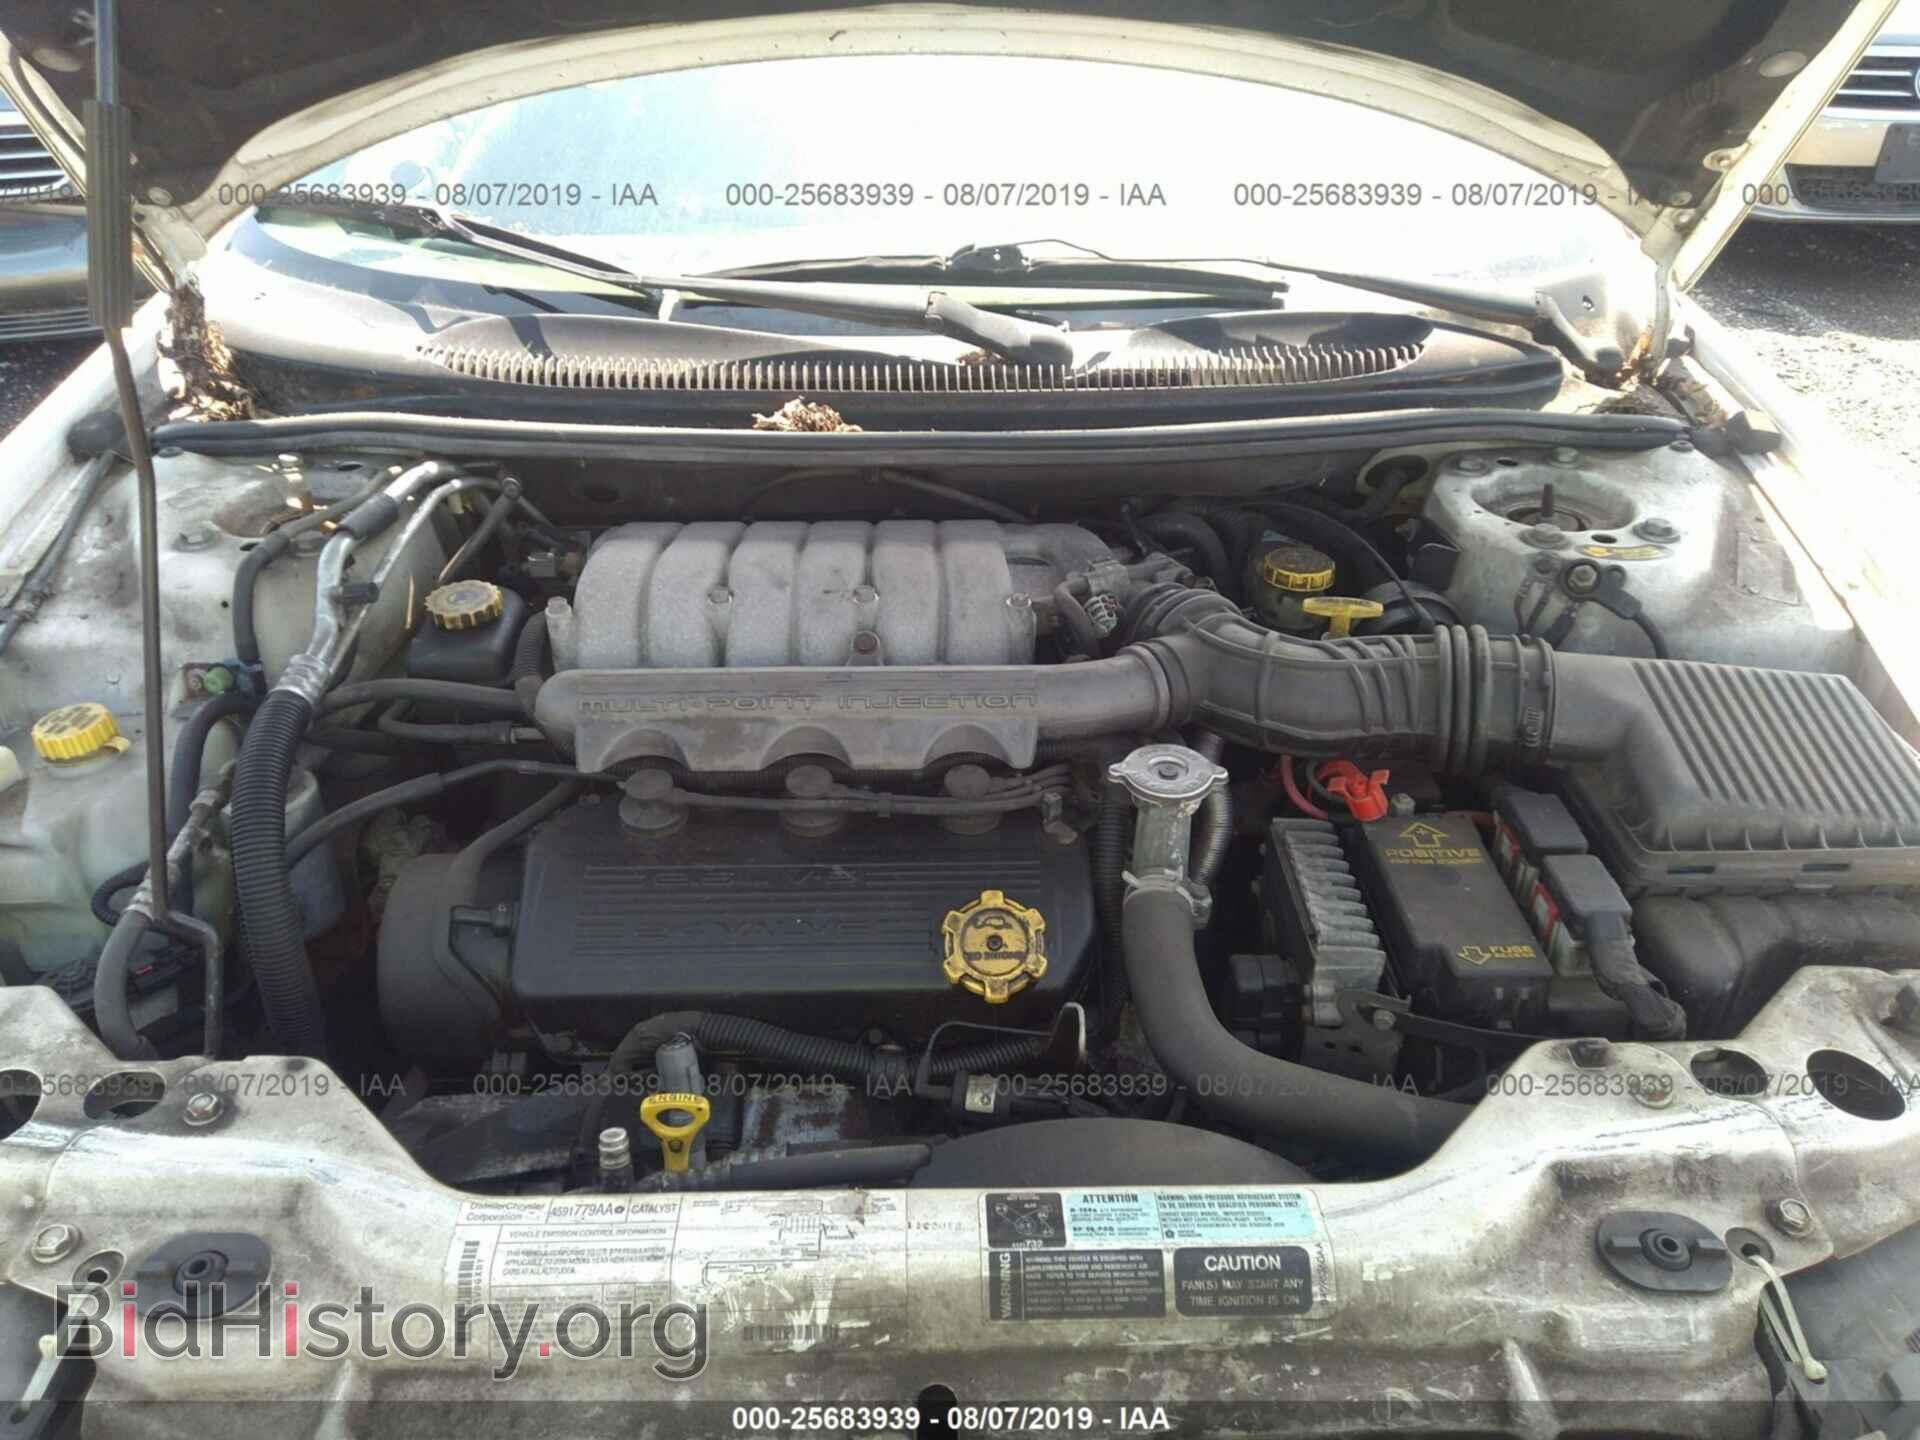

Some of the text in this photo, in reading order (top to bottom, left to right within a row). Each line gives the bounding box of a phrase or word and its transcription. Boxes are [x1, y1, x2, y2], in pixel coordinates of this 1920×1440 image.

[1082, 1193, 1139, 1204] ATTENTION
[631, 1202, 678, 1215] CATALYST
[1202, 1253, 1283, 1273] CAUTION
[1181, 1277, 1305, 1291] FAN(S) MAY START ANY
[1190, 1294, 1301, 1307] TIME IGNITION IS ON
